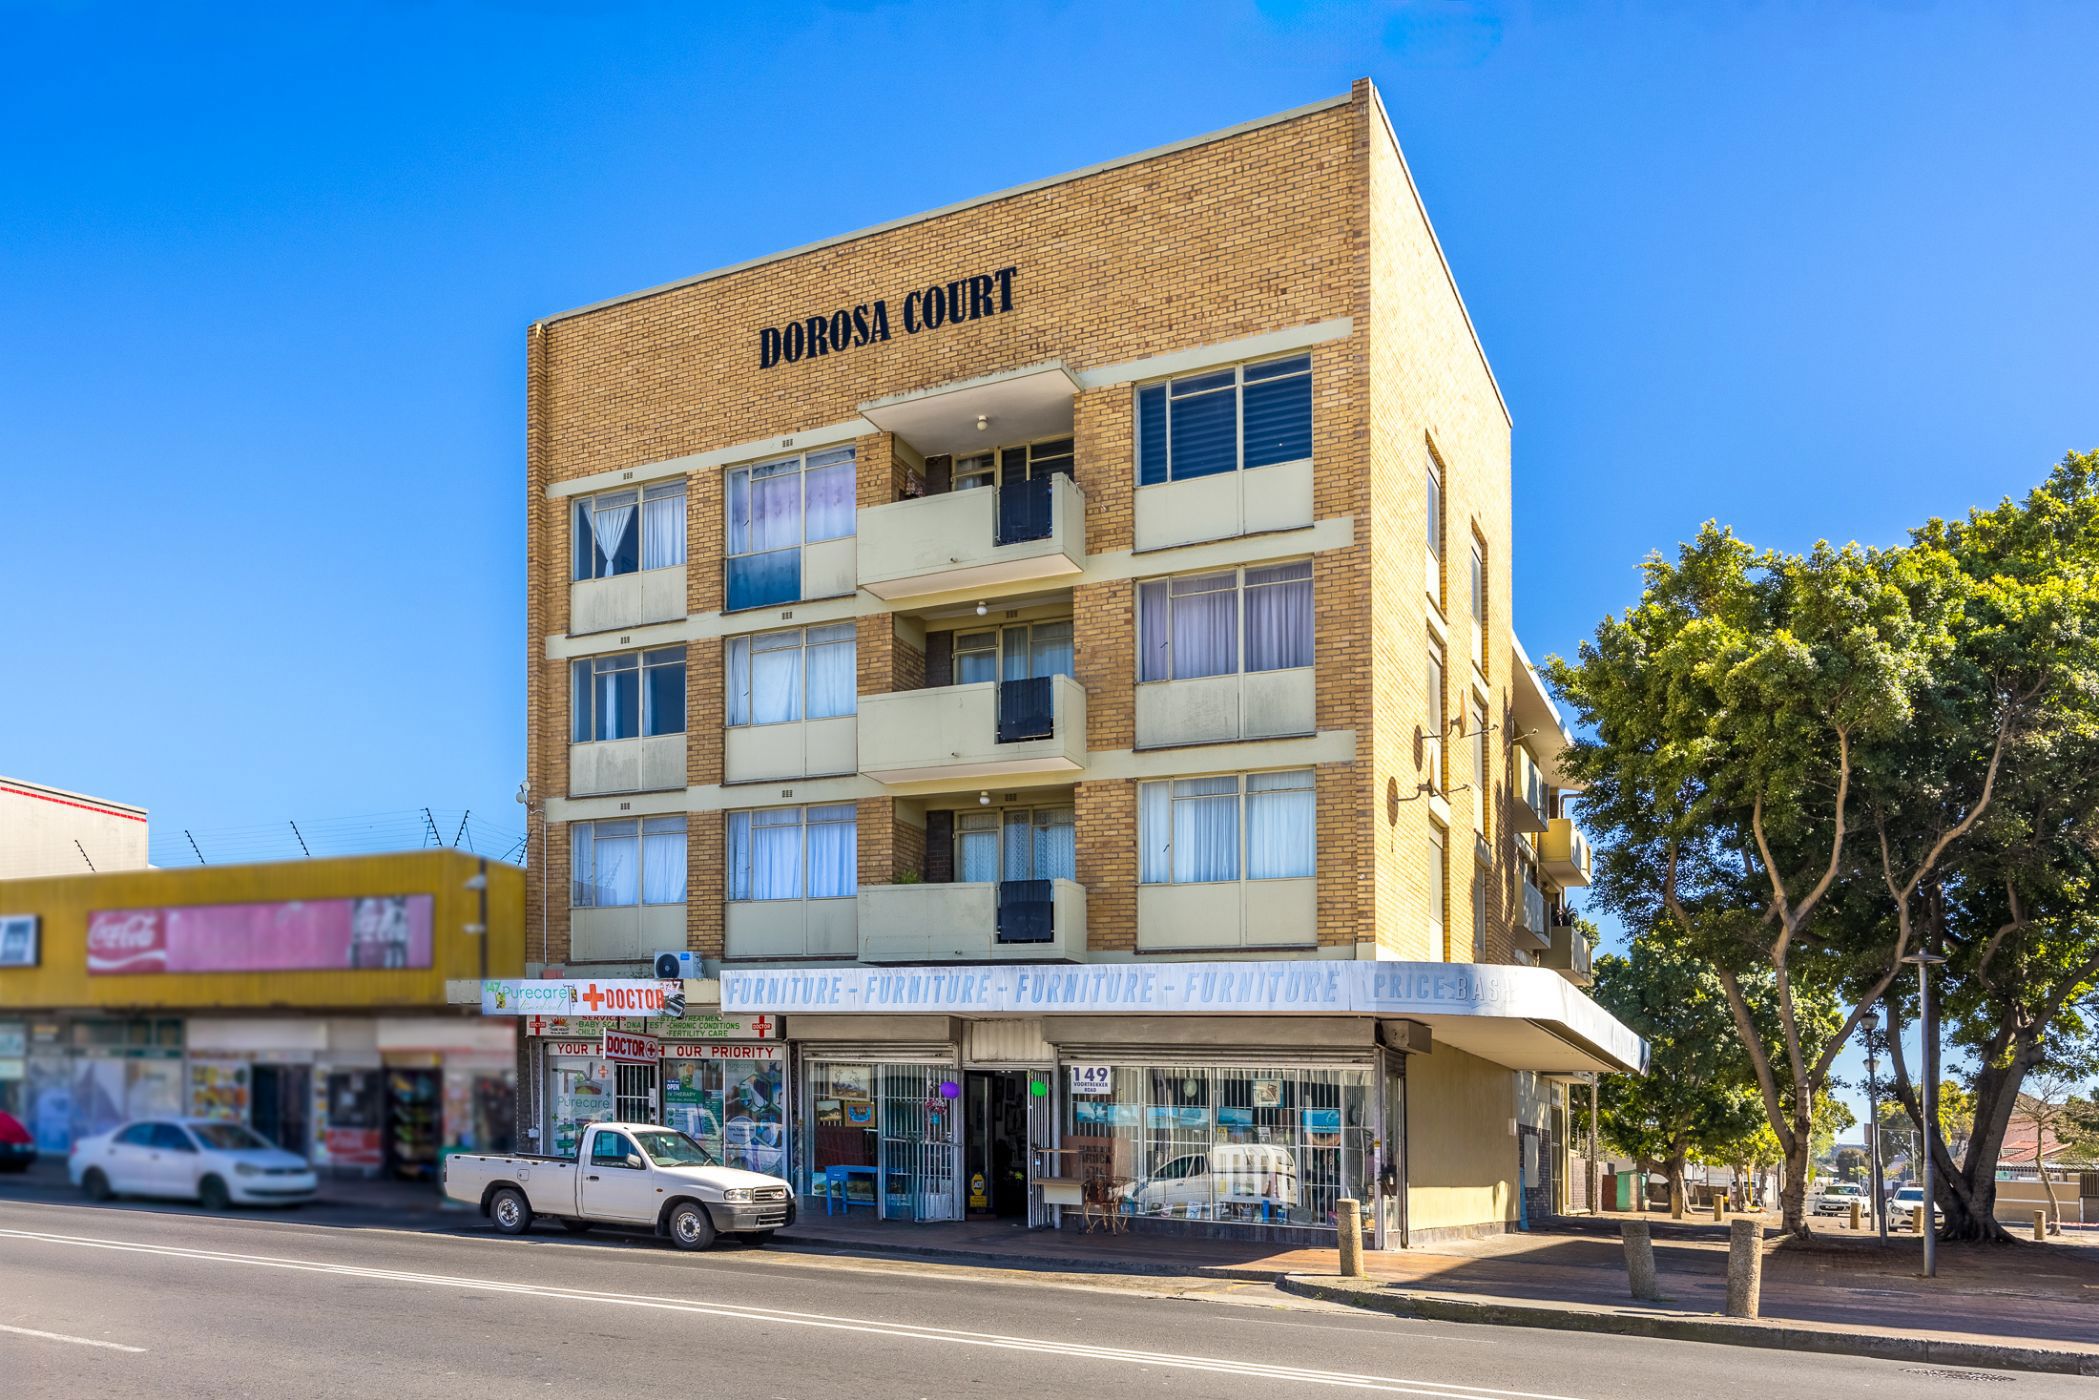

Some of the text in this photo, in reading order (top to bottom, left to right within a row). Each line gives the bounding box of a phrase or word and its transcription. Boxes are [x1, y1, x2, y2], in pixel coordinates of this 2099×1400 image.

[759, 266, 1018, 369] DOROSA COURT
[502, 985, 568, 999] Purecare
[662, 981, 682, 992] 147
[728, 976, 843, 1005] FURNITURE
[864, 975, 993, 1005] FURNITURE
[1015, 972, 1157, 1004] FURNITURE
[1183, 970, 1340, 1003] FURNITURE
[605, 987, 666, 1010] DOCTOR
[578, 1020, 618, 1029] BABY SCA
[702, 1022, 740, 1030] CONDITIONS
[576, 1028, 597, 1036] CHILD
[557, 1043, 589, 1055] YOUR
[606, 1036, 646, 1058] DOCTOR
[676, 1046, 702, 1057] OUR
[711, 1046, 775, 1059] PRIORITY
[1072, 1067, 1109, 1082] 149
[666, 1083, 680, 1091] OPEN
[557, 1095, 610, 1109] Purecare
